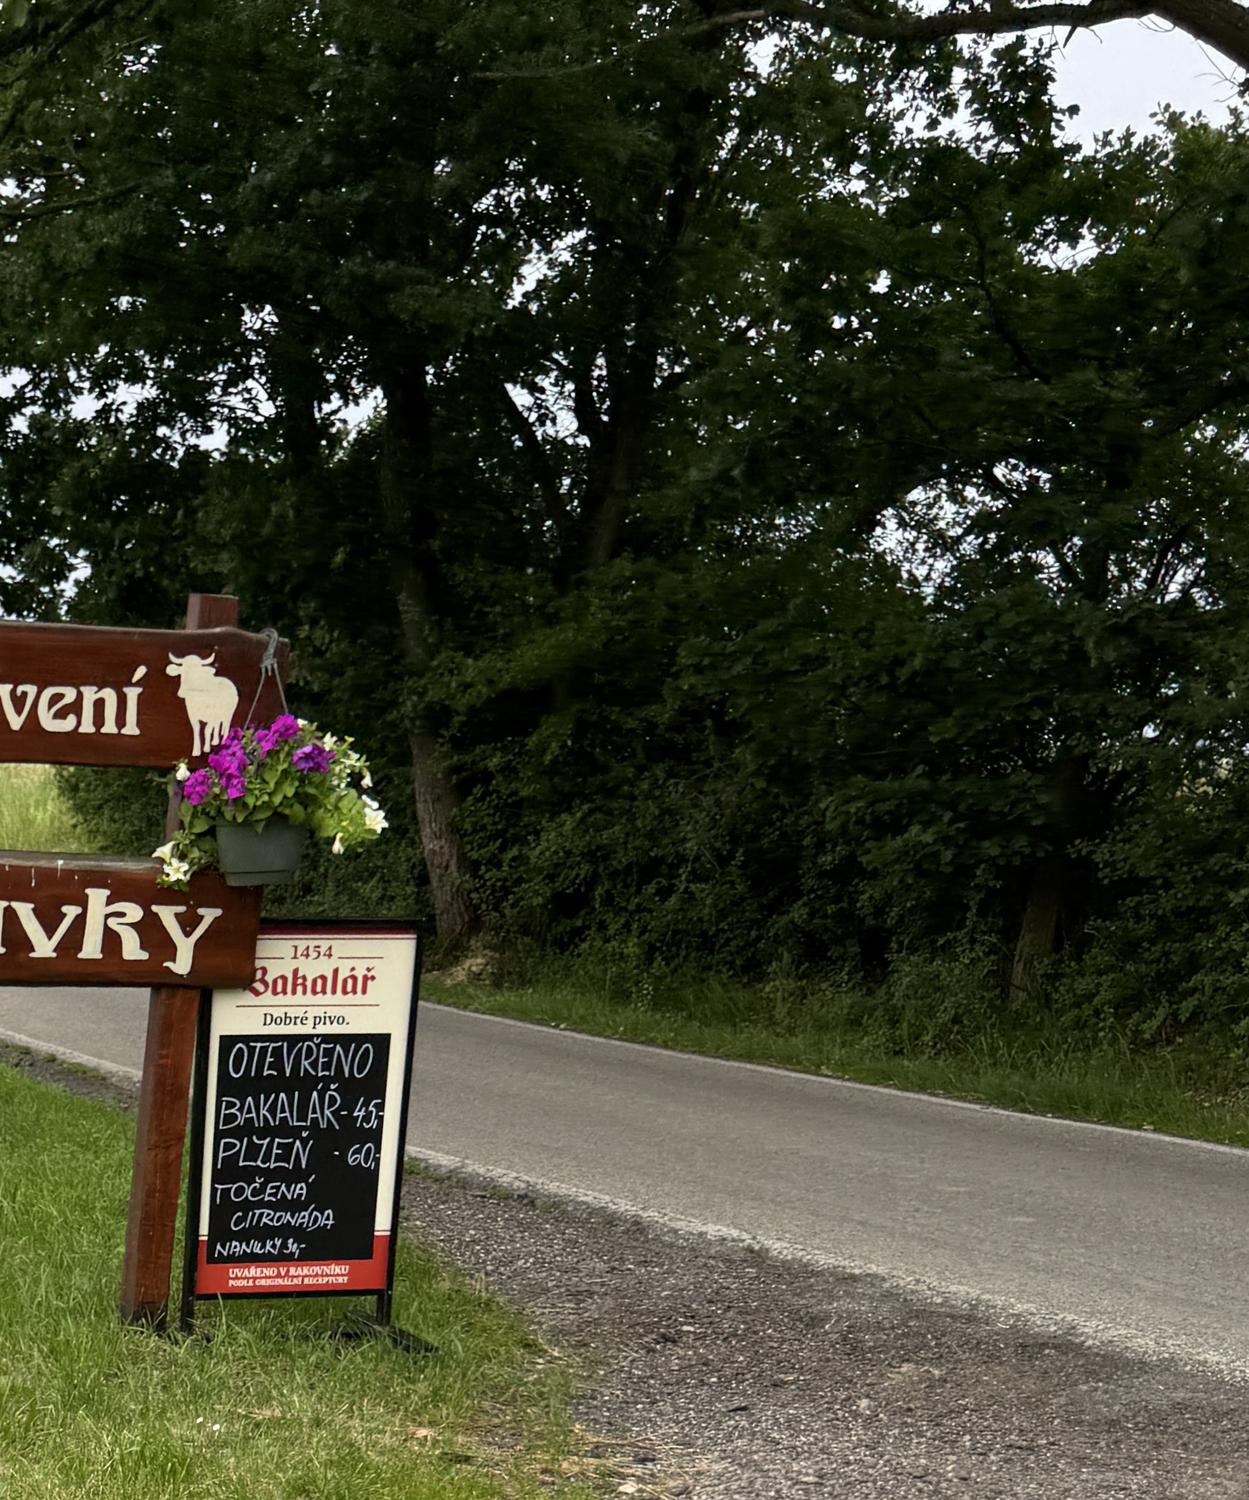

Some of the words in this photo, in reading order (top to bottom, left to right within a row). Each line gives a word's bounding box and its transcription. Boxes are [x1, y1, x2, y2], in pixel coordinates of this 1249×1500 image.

[290, 945, 334, 960] 1454
[245, 965, 376, 997] Bakalář
[263, 1011, 308, 1026] Dobré
[312, 1014, 350, 1029] pivo.
[228, 1037, 374, 1078] OTEVŘENO
[217, 1131, 313, 1170] PLZEŇ
[214, 1174, 316, 1205] TOČENÁ
[230, 1204, 335, 1232] CITRONÁDA
[228, 1267, 276, 1278] UVAŘENO
[278, 1267, 286, 1277] V
[289, 1264, 349, 1276] RAKOVNÍKU
[228, 1278, 254, 1288] PODLE
